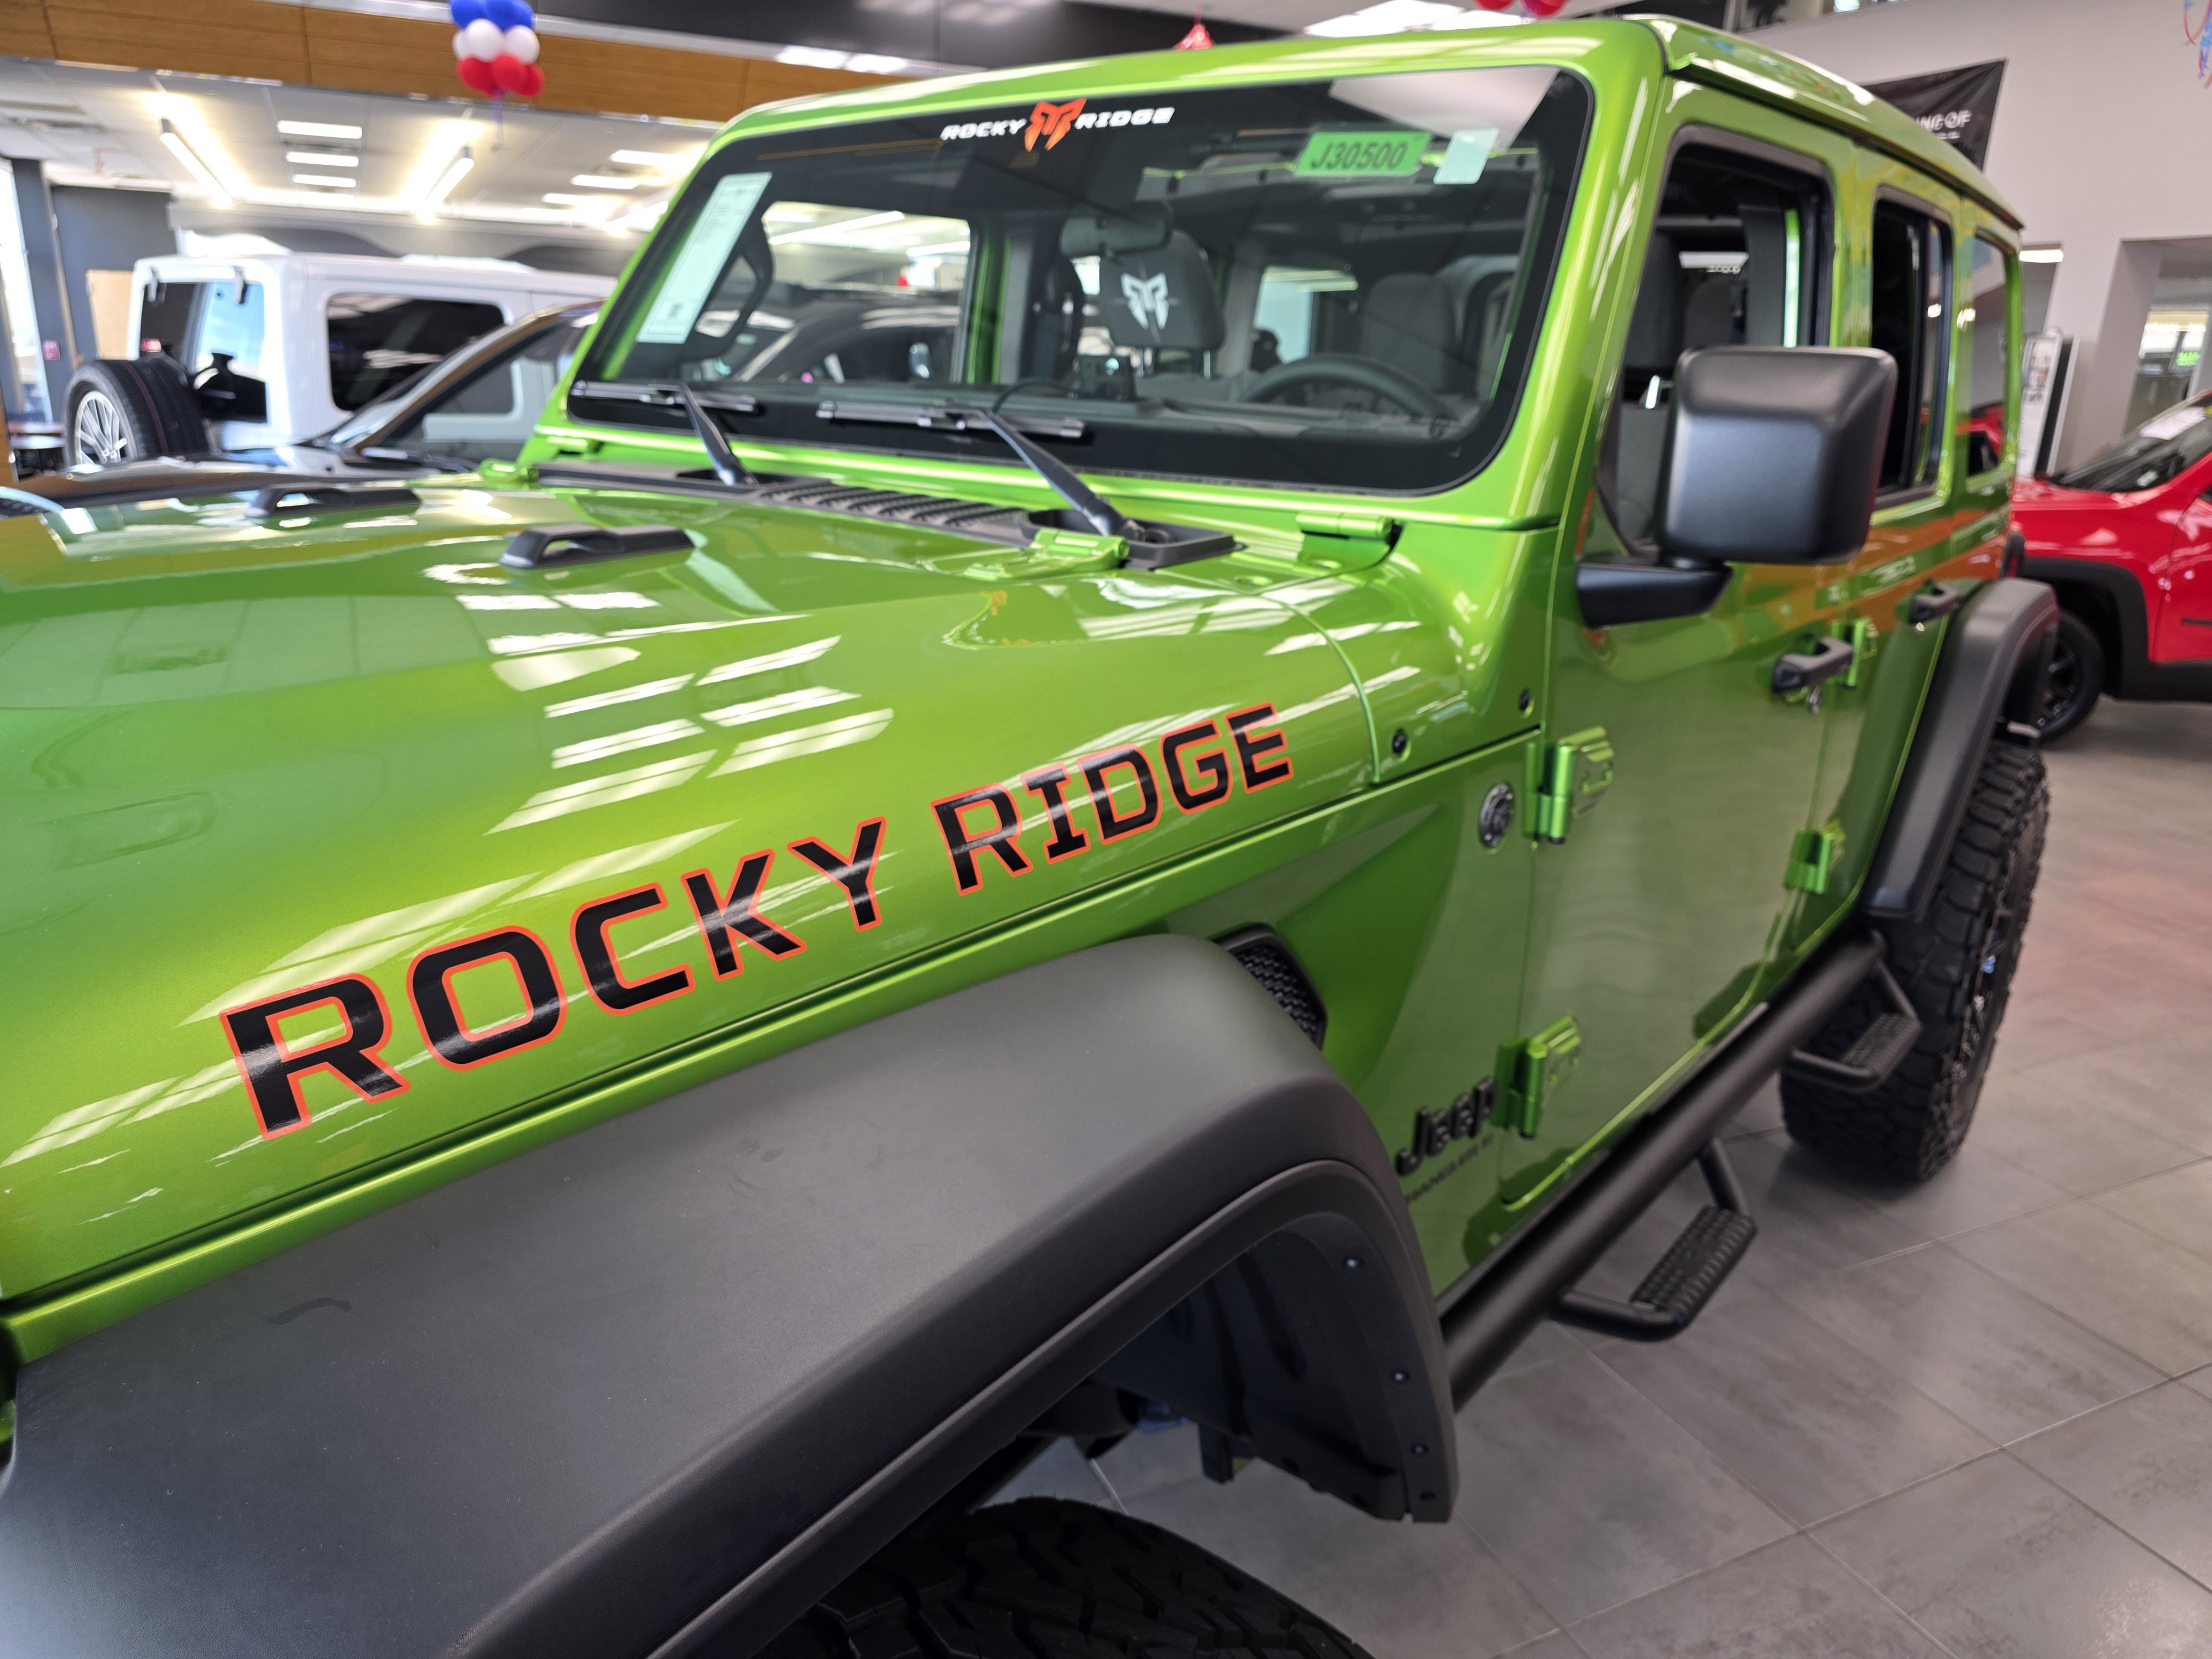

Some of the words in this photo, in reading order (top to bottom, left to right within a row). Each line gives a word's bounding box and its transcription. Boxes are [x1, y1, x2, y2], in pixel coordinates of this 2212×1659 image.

[940, 118, 1027, 140] ROCKY
[1074, 107, 1175, 129] RIDGE
[1944, 109, 1972, 129] OF
[1310, 142, 1407, 169] J30500
[220, 817, 887, 1140] ROCKY
[931, 702, 1293, 895] RIDGE
[1395, 1076, 1496, 1177] Jeep
